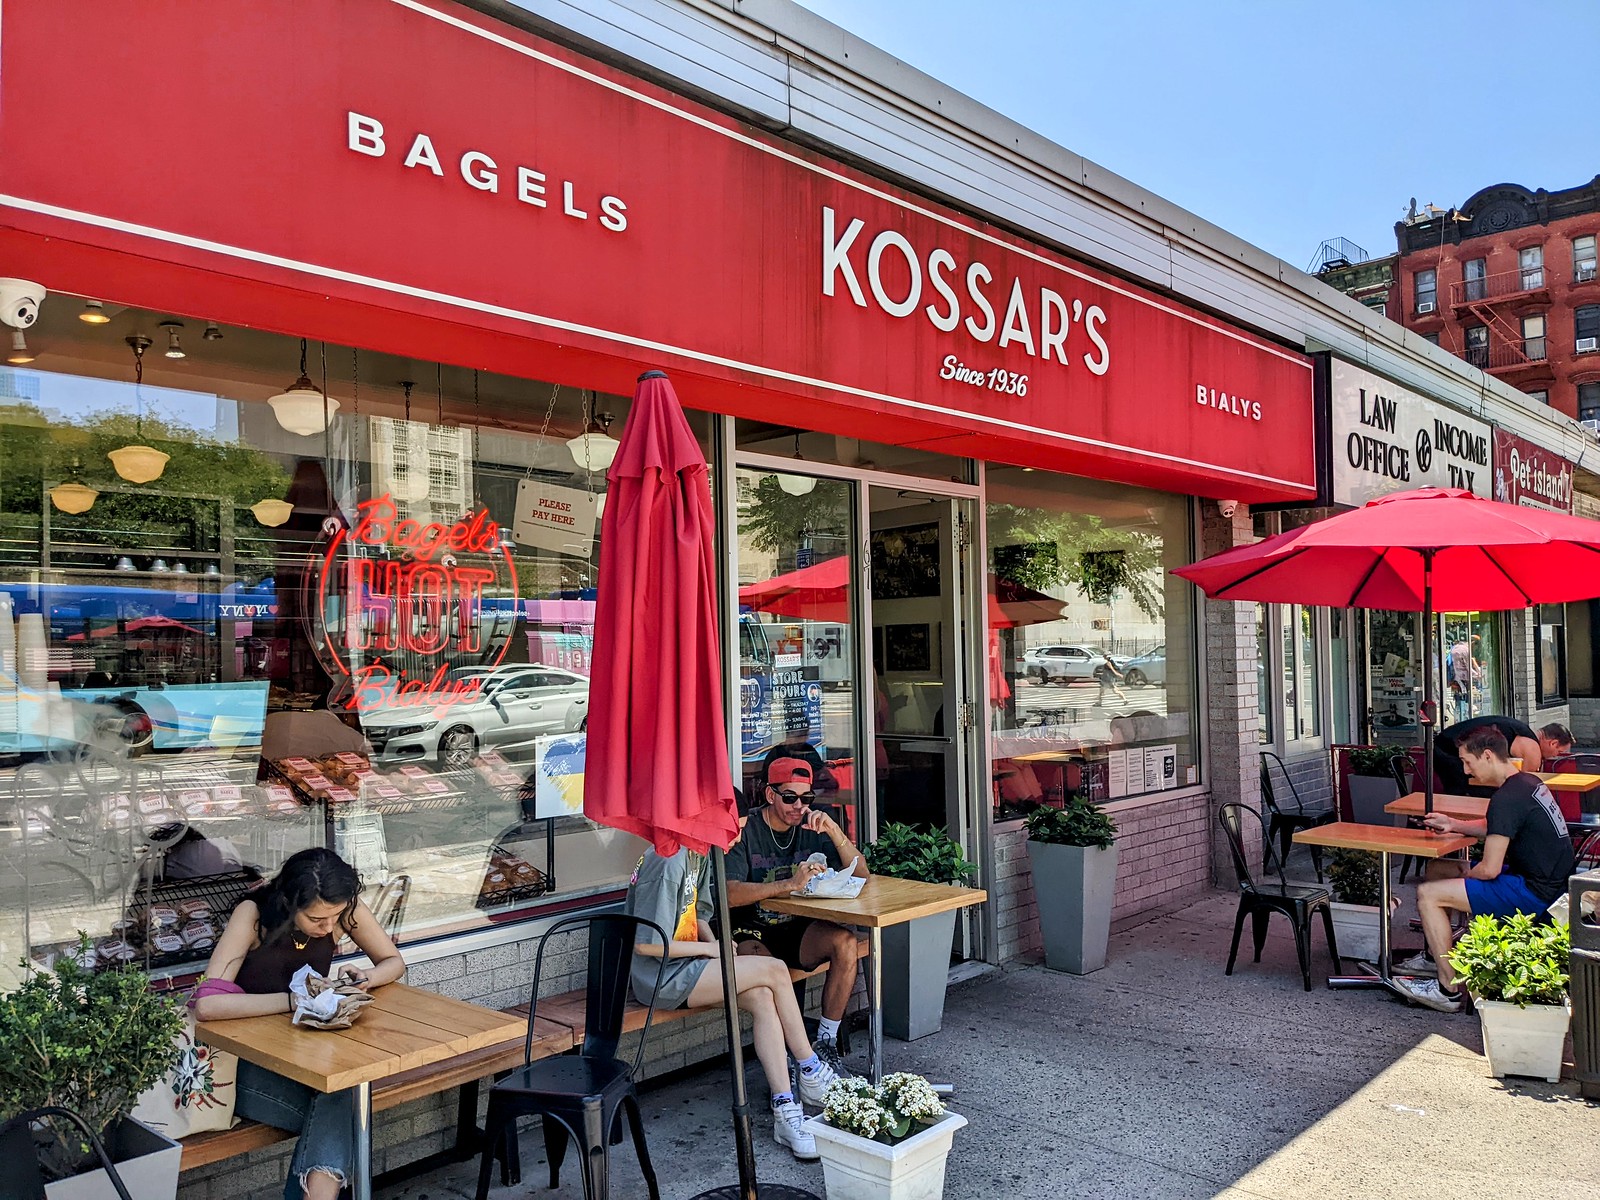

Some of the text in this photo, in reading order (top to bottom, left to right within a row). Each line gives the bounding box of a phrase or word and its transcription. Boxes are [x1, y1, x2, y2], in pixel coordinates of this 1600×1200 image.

[348, 111, 628, 233] BAGELS
[822, 206, 1110, 377] KOSSAR'S
[940, 354, 1029, 397] Since 1936
[1196, 384, 1263, 421] BIALYS
[1359, 388, 1397, 434] LAW
[1347, 432, 1410, 482] OFFICE
[1434, 418, 1488, 467] INCOME
[1447, 464, 1475, 493] TAX
[1510, 448, 1531, 506] Pet
[1533, 457, 1564, 502] island
[350, 492, 500, 562] Bagels
[532, 509, 576, 527] PAY HERE
[538, 498, 572, 513] PLEASE
[345, 558, 495, 655] HOT
[344, 656, 482, 720] Bialys
[772, 671, 804, 685] STORE
[772, 684, 807, 699] HOURS
